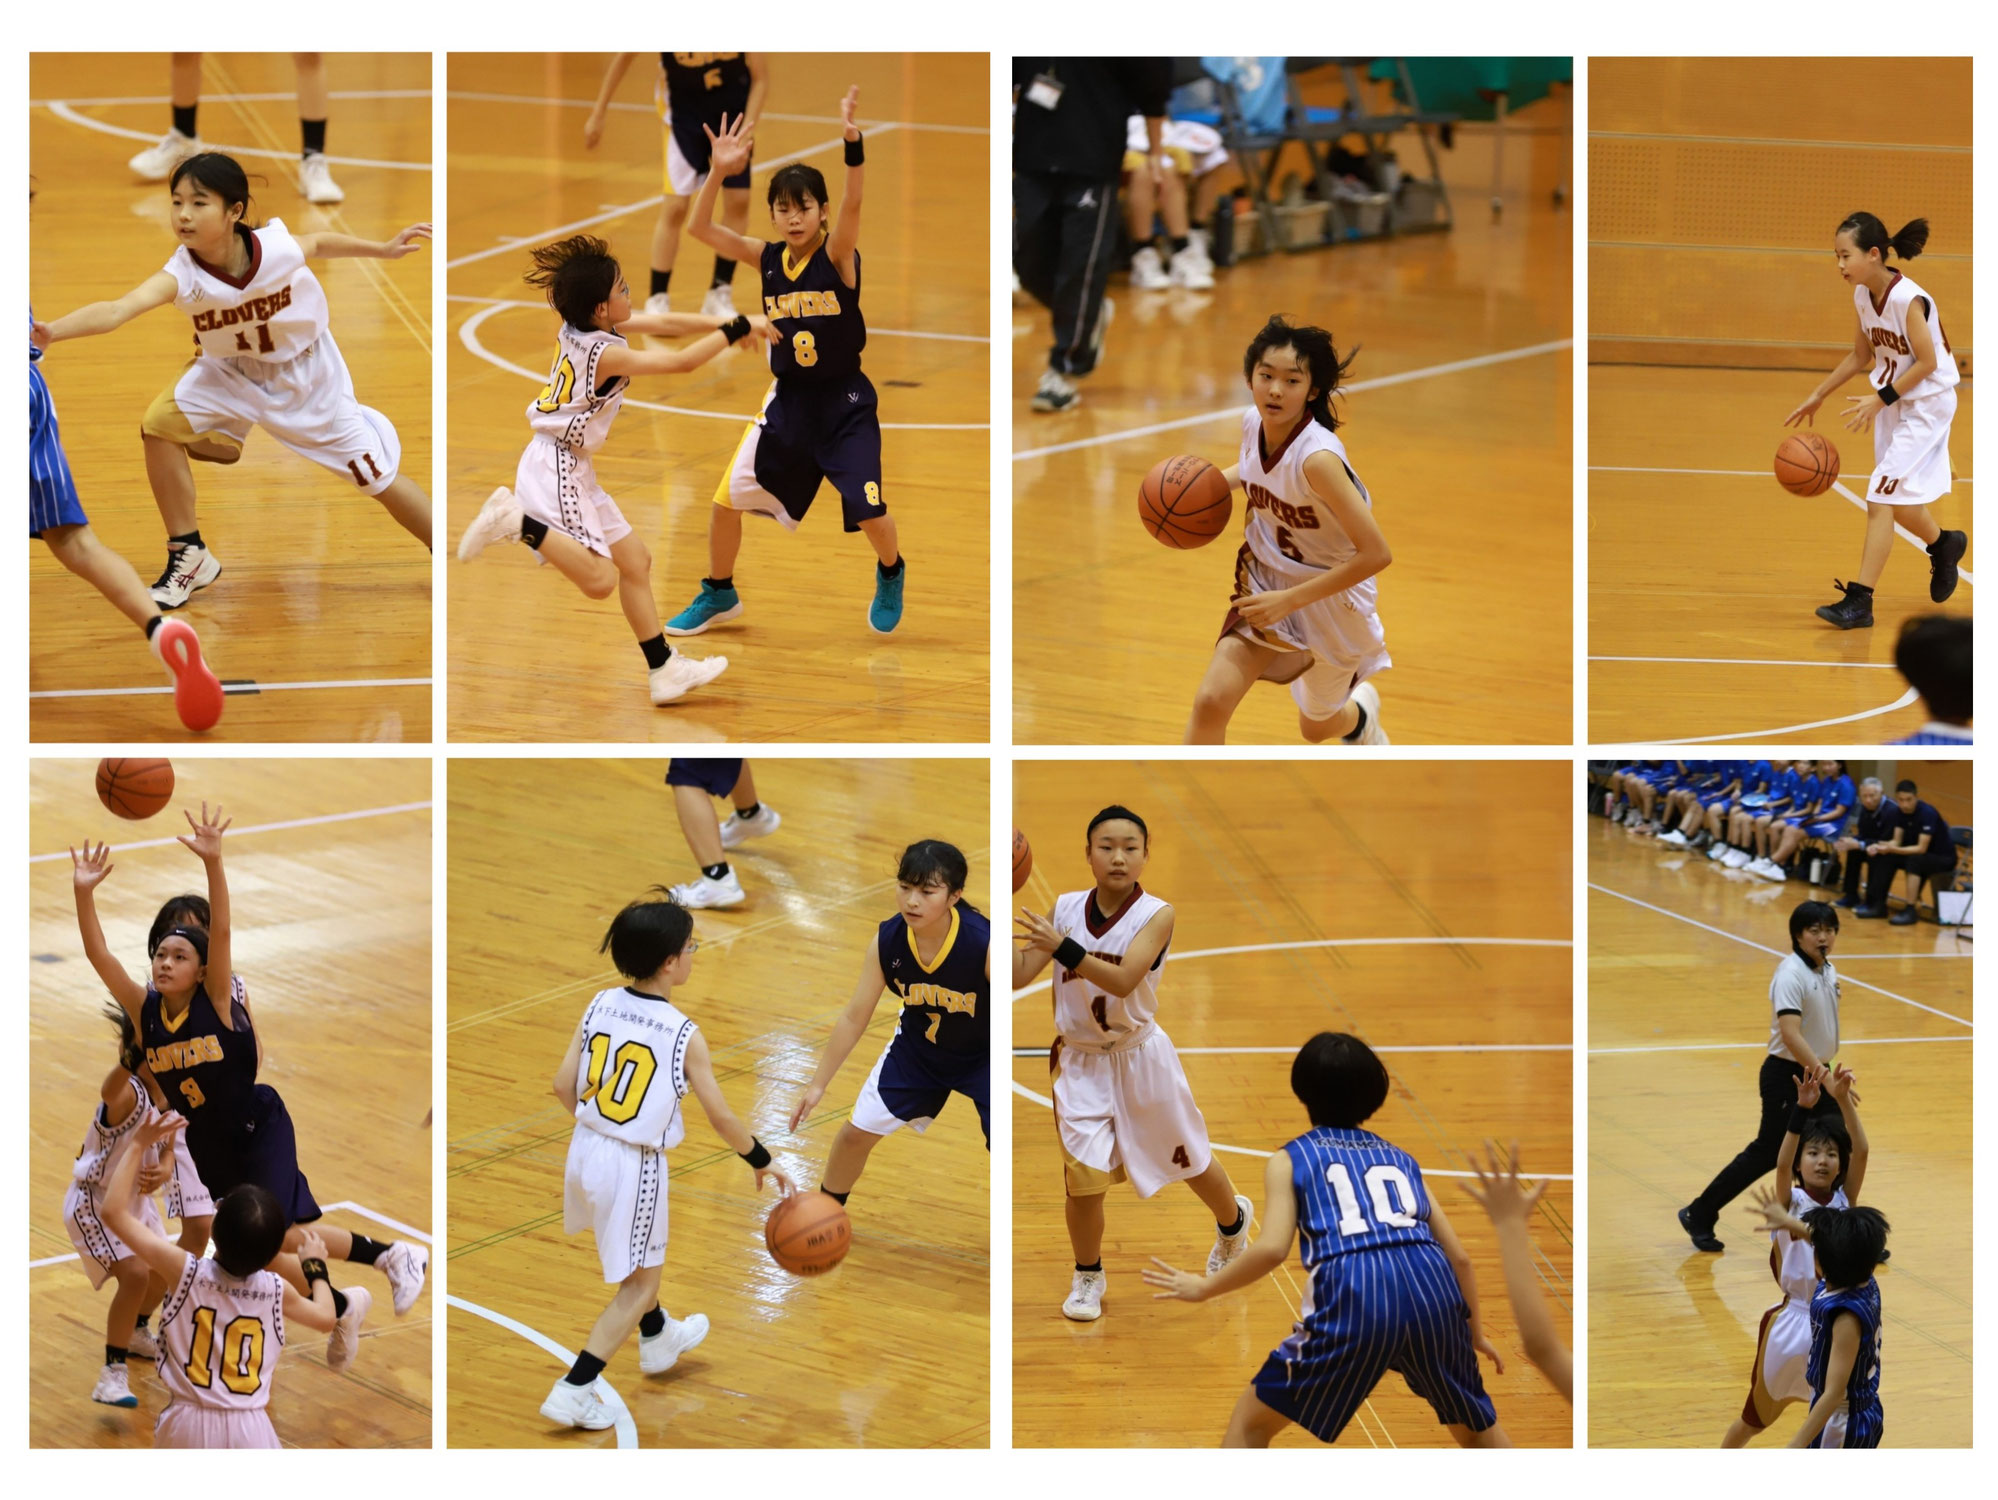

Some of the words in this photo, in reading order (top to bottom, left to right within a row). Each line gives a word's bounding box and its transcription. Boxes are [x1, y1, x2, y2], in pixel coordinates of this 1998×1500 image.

[192, 284, 292, 332] CLOVERS
[764, 290, 841, 320] CLOVERS
[235, 322, 275, 354] 11
[792, 330, 818, 367] 8
[347, 452, 383, 487] 11
[1875, 475, 1899, 495] 10
[864, 481, 880, 506] 8
[1276, 525, 1304, 564] 5
[925, 1012, 942, 1045] 7
[1091, 995, 1112, 1032] 4
[146, 1034, 224, 1074] CLOVERS
[179, 1076, 206, 1109] 9
[580, 1031, 658, 1126] 10
[1172, 1145, 1191, 1169] 4
[1325, 1163, 1417, 1237] 10
[184, 1305, 265, 1396] 10
